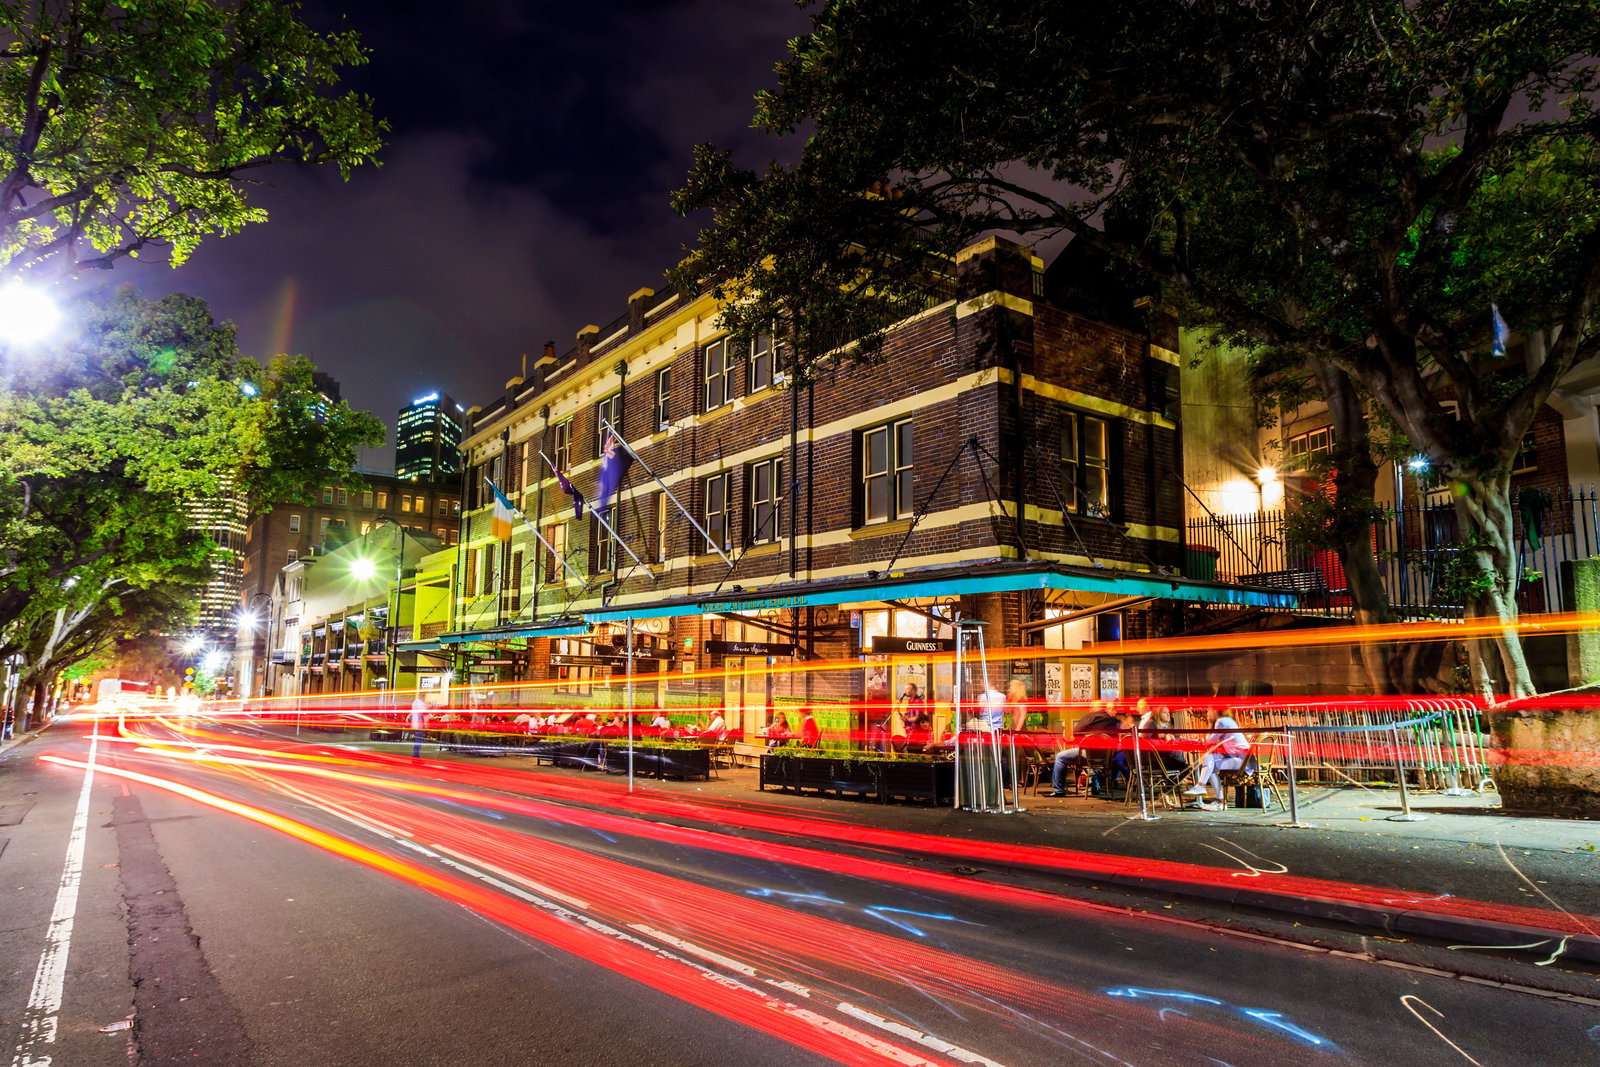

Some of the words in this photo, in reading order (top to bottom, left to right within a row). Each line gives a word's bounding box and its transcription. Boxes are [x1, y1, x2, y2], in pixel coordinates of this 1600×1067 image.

[703, 599, 768, 613] MERCANTILE
[769, 594, 809, 608] HOTEL
[906, 640, 937, 651] GUINNESS
[1073, 679, 1091, 689] BAR
[1101, 679, 1118, 689] BAR
